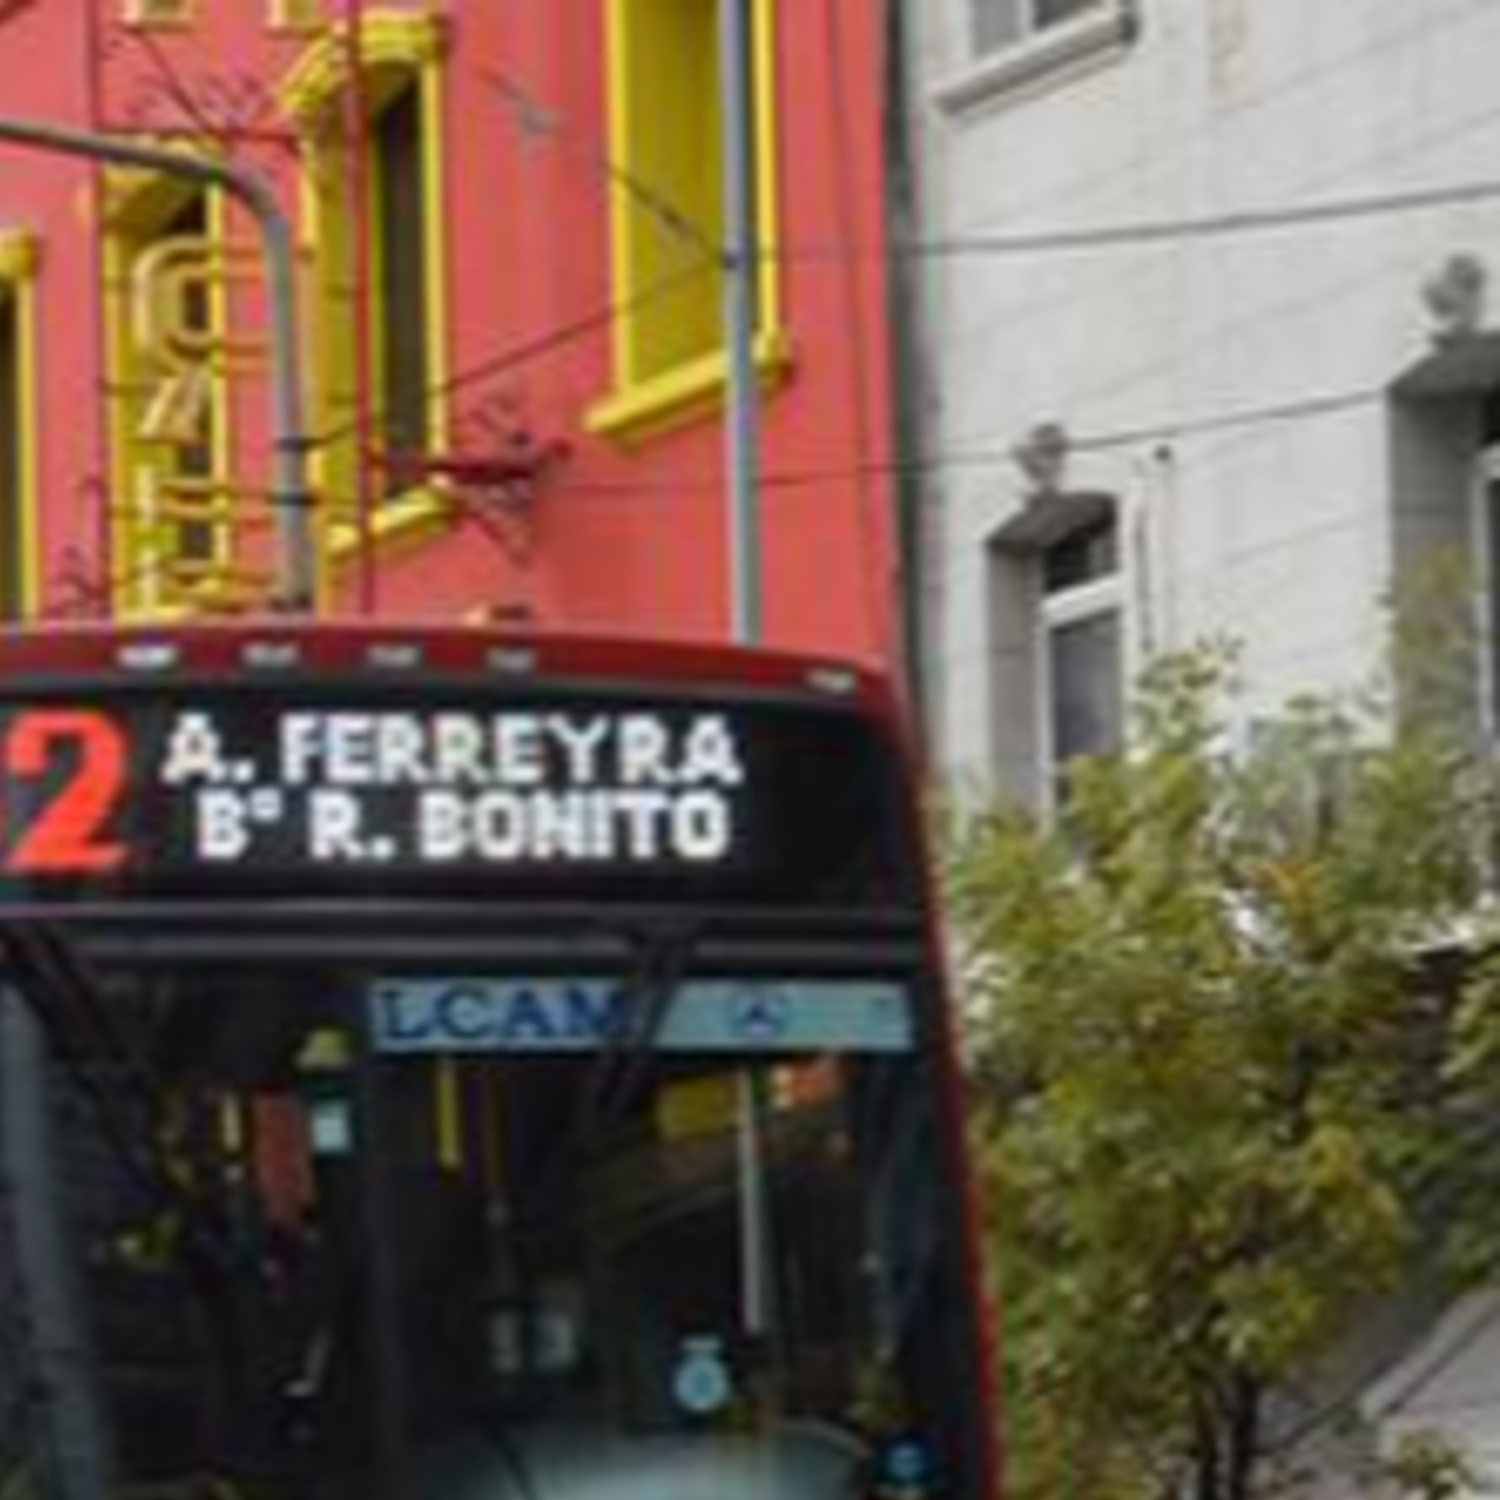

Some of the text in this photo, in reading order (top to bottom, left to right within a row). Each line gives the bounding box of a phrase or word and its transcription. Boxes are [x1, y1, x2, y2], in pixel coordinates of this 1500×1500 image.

[160, 711, 744, 785] A. FERREYRA
[308, 787, 396, 859] R.
[419, 787, 730, 859] BONITO
